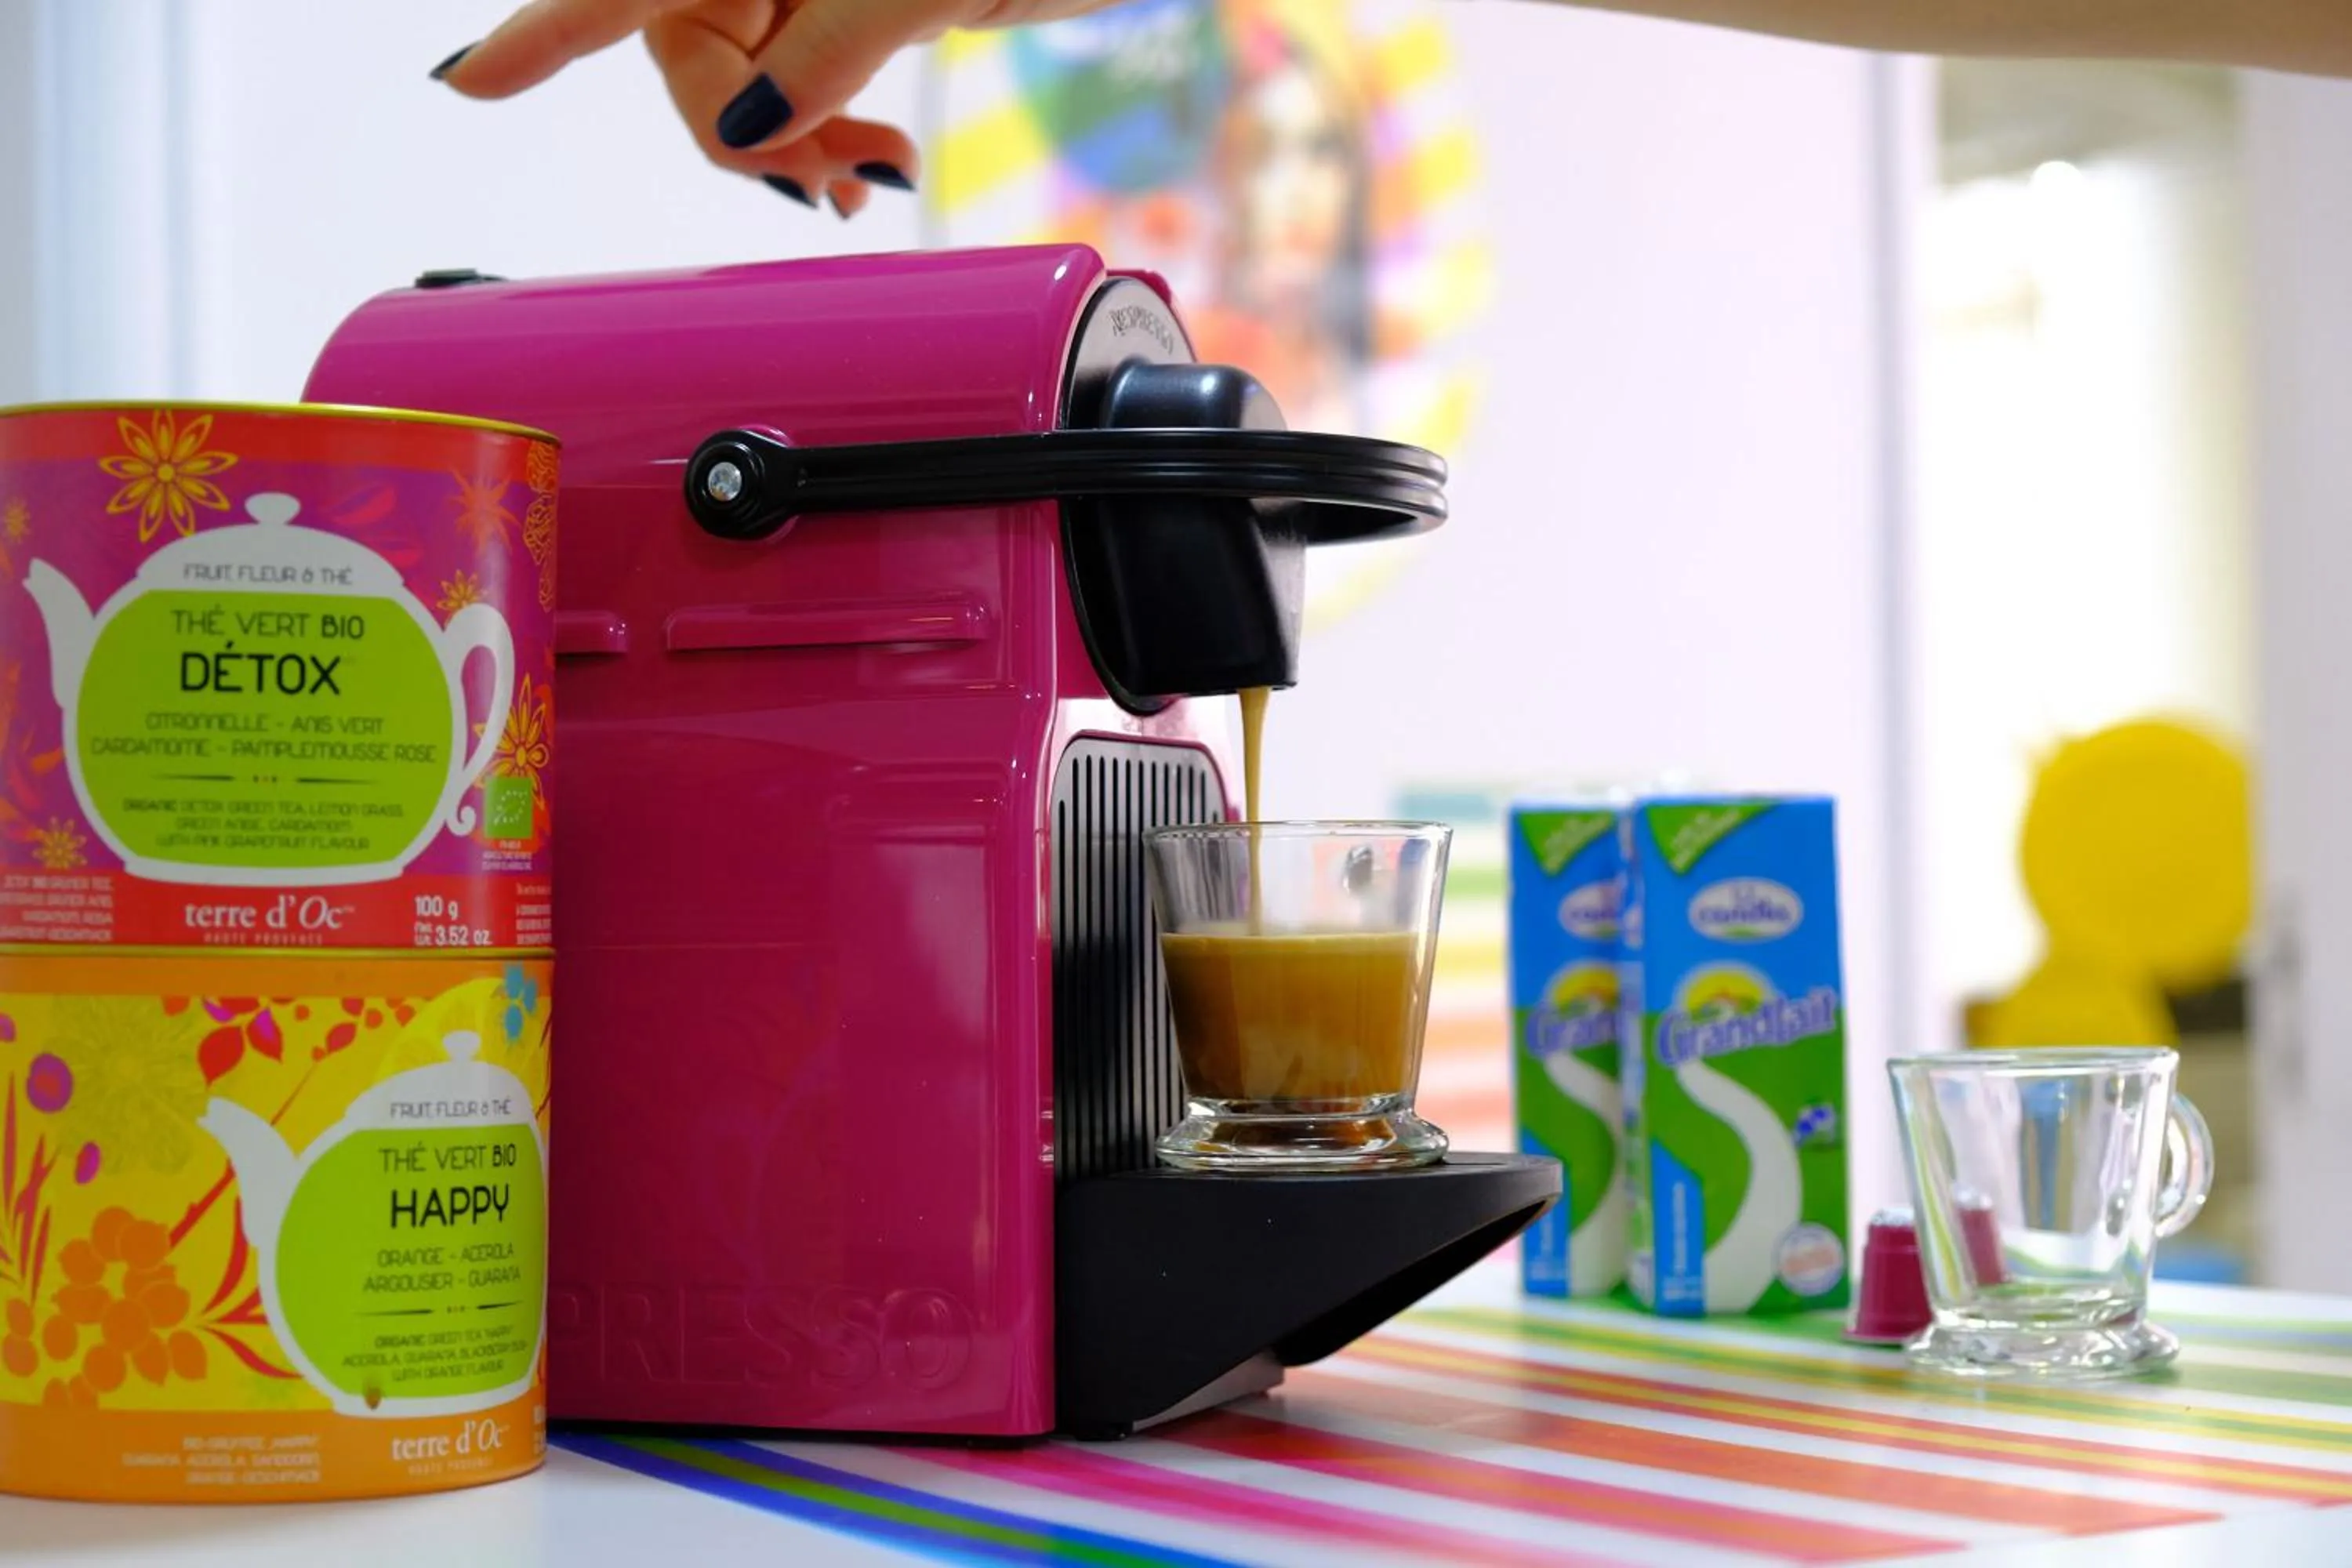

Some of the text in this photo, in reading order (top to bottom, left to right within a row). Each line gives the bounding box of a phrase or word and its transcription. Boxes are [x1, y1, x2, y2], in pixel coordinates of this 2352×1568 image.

[238, 564, 297, 583] FLEUR
[321, 564, 352, 585] THÉ
[170, 603, 365, 640] THÉ VERT BIO
[180, 640, 341, 695] DÉTOX
[145, 712, 270, 732] CITRONNELLE
[290, 715, 333, 734] ANIS
[337, 716, 385, 735] VERT
[92, 736, 211, 757] CARDAMOME
[231, 738, 390, 761] PAMPLEMOUSSE
[394, 744, 437, 764] ROSE
[185, 903, 256, 928] terre
[415, 895, 459, 921] 100 g
[436, 924, 468, 946] 3.52
[437, 1101, 477, 1117] FLEUR
[492, 1096, 511, 1115] THÉ
[378, 1142, 516, 1172] THÉ VERT BIO
[390, 1182, 510, 1229] HAPPY
[377, 1247, 444, 1268] ORANGE
[362, 1272, 453, 1292] ARGOUSIER
[468, 1265, 521, 1288] GUARANA
[390, 1432, 449, 1461] terre
